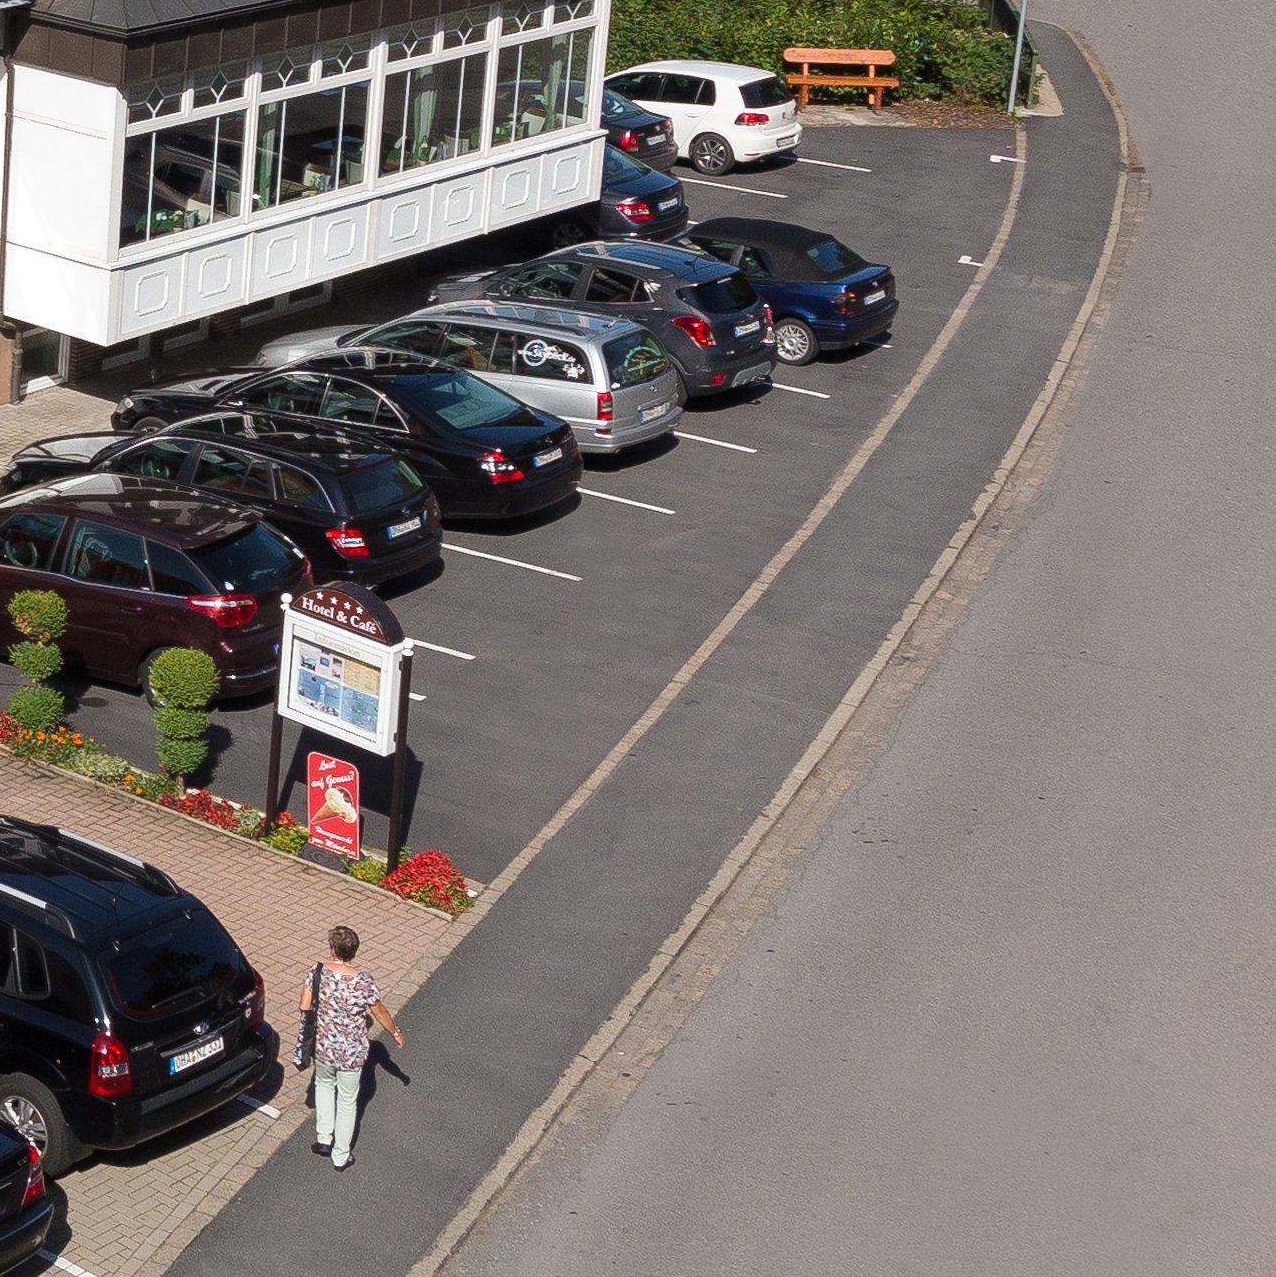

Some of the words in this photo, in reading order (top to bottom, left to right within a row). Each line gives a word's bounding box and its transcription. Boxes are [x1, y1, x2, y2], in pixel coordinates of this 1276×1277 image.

[302, 596, 335, 618] Hotel
[336, 611, 348, 624] &
[350, 615, 377, 634] Café
